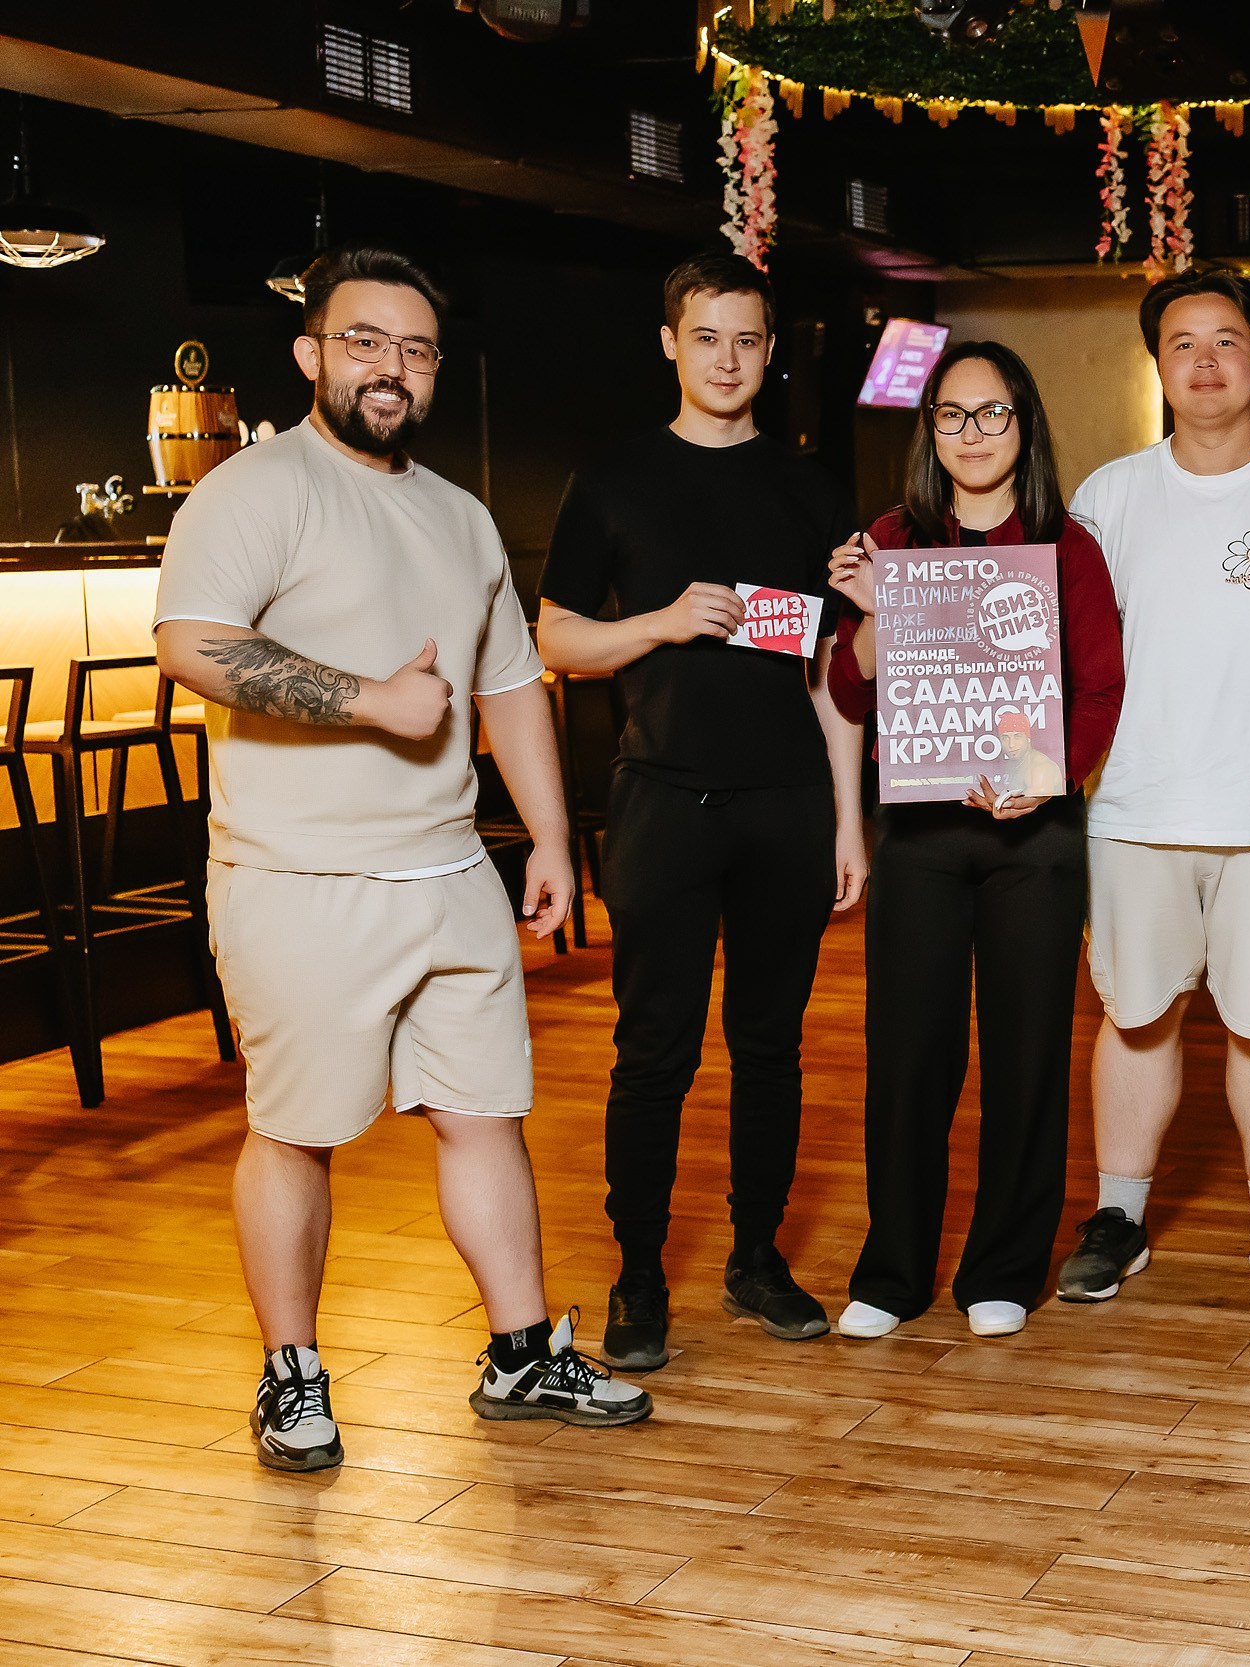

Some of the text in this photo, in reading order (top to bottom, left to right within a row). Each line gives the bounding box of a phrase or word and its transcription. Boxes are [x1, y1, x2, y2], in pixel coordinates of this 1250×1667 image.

[884, 559, 999, 583] 2 МЕСТО
[743, 616, 809, 639] ПЛИЗ!
[877, 612, 926, 632] ДАЖЕ
[983, 608, 1049, 640] ПЛИЗ!
[893, 626, 978, 644] ЕДИНОЖДЫ
[886, 649, 960, 662] КОМАНДЕ,
[887, 660, 1045, 676] КОТОРАЯ БЫЛА ПОЧТИ
[889, 734, 1009, 765] КРУТО
